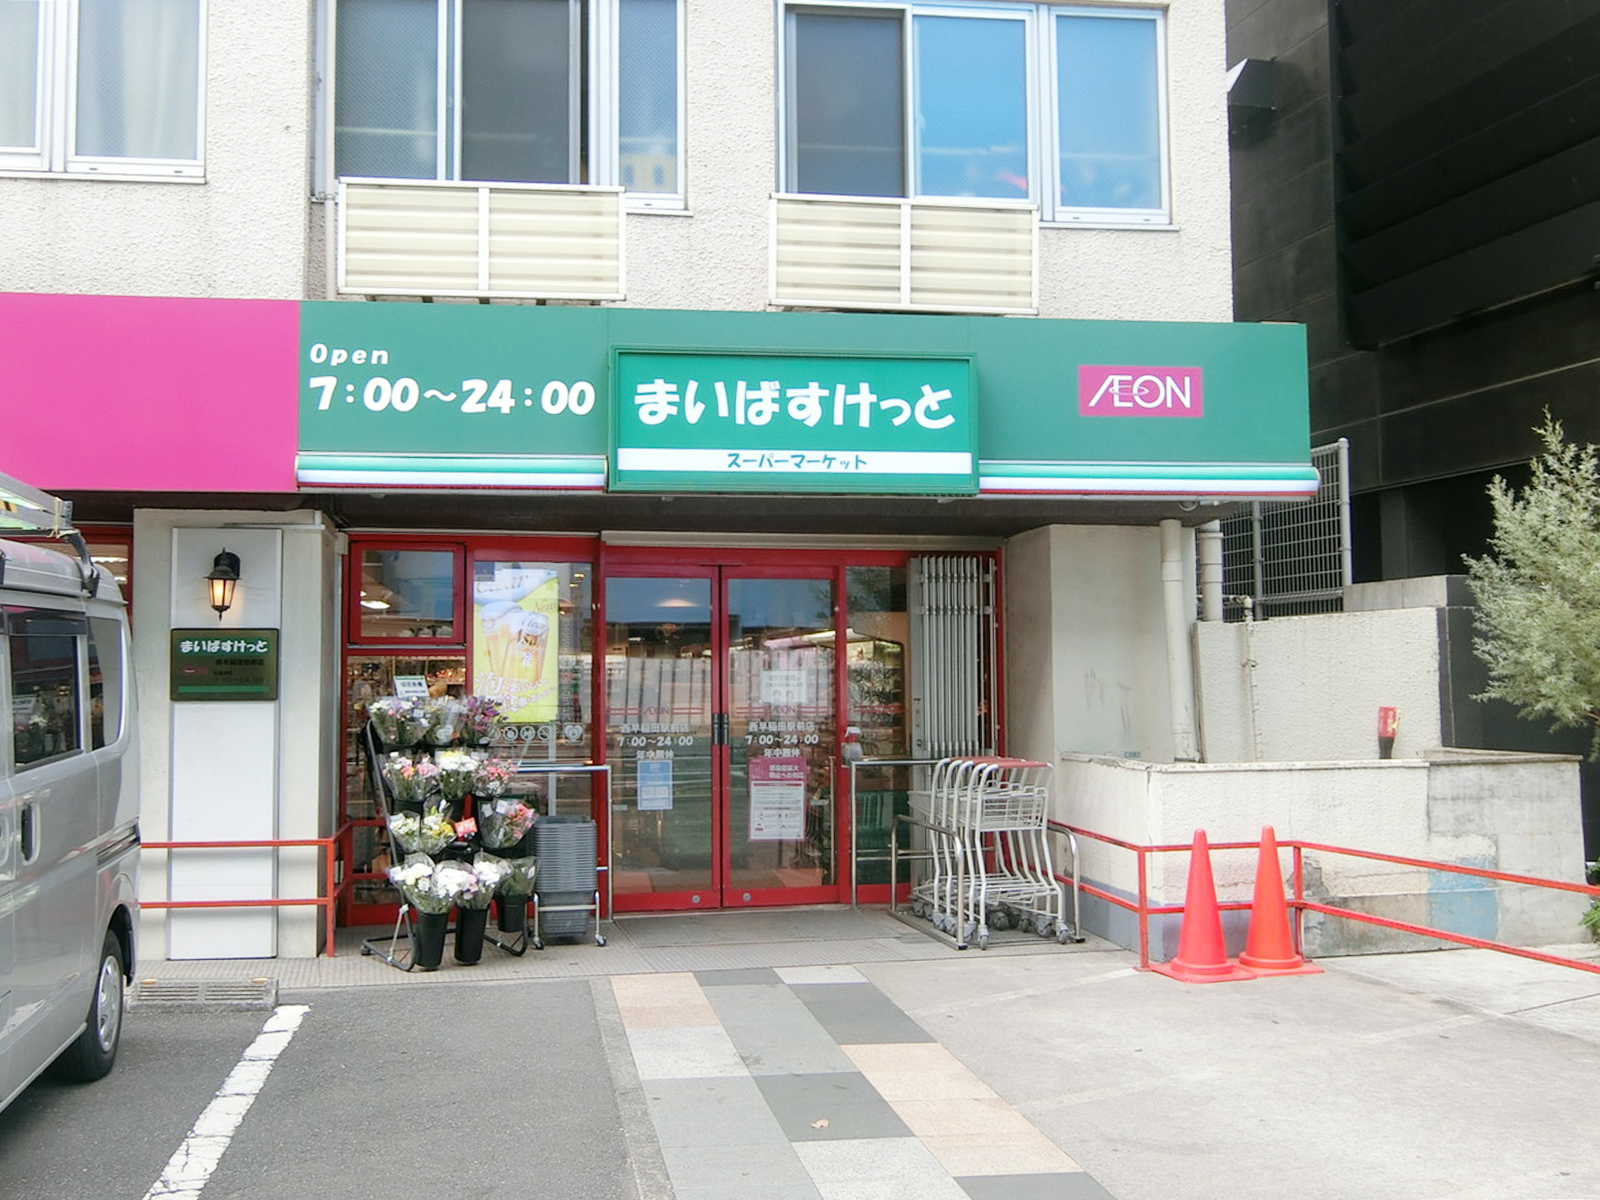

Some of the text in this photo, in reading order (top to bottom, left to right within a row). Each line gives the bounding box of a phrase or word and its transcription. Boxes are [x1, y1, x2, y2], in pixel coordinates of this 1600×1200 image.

[309, 343, 389, 367] Open
[634, 379, 956, 429] まいばすけっと
[727, 452, 867, 471] スーパーマーケット
[180, 640, 268, 653] まいばすけっと
[749, 721, 815, 732] 西早稲田駅前店
[636, 749, 674, 760] 年中無休
[763, 748, 800, 758] 年中無休
